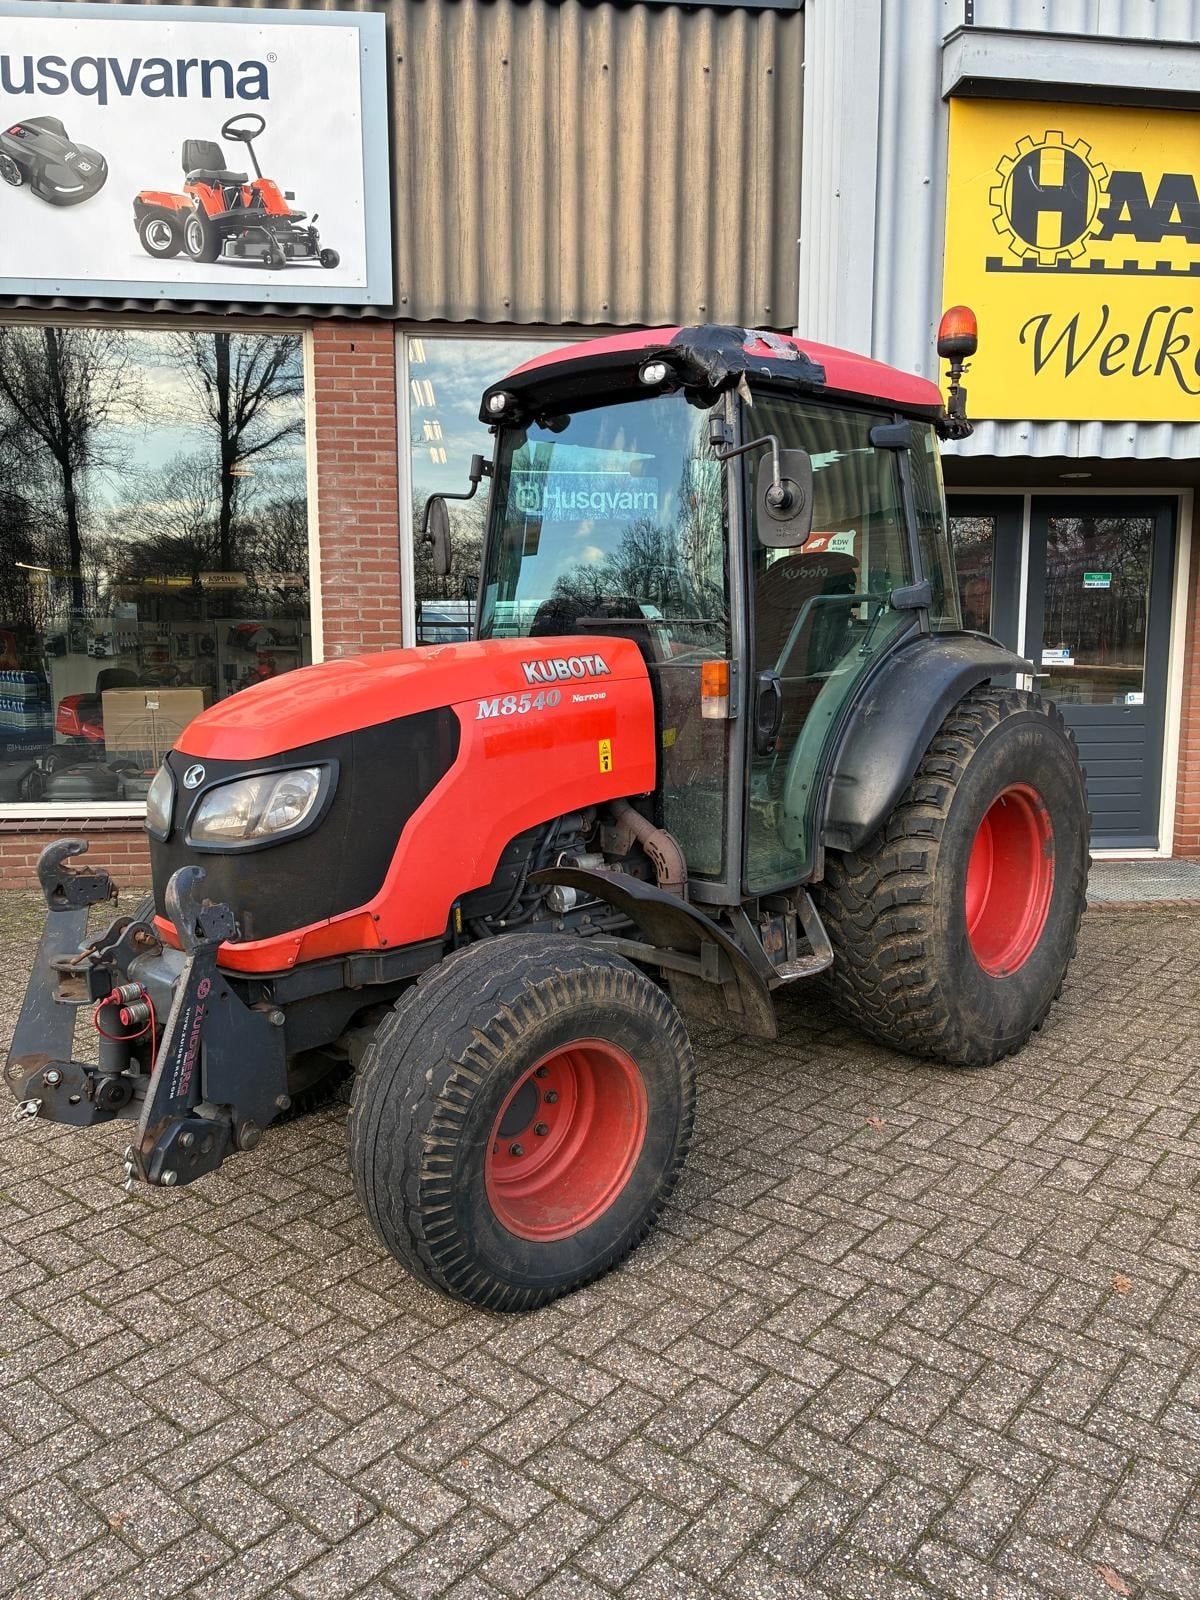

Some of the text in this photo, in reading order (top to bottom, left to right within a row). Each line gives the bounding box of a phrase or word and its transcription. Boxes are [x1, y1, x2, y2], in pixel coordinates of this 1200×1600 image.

[1019, 305, 1200, 395] Welk
[521, 654, 611, 684] KUBOTA
[475, 689, 606, 719] M8540 Narrow
[179, 1004, 204, 1096] ZUIDBERG
